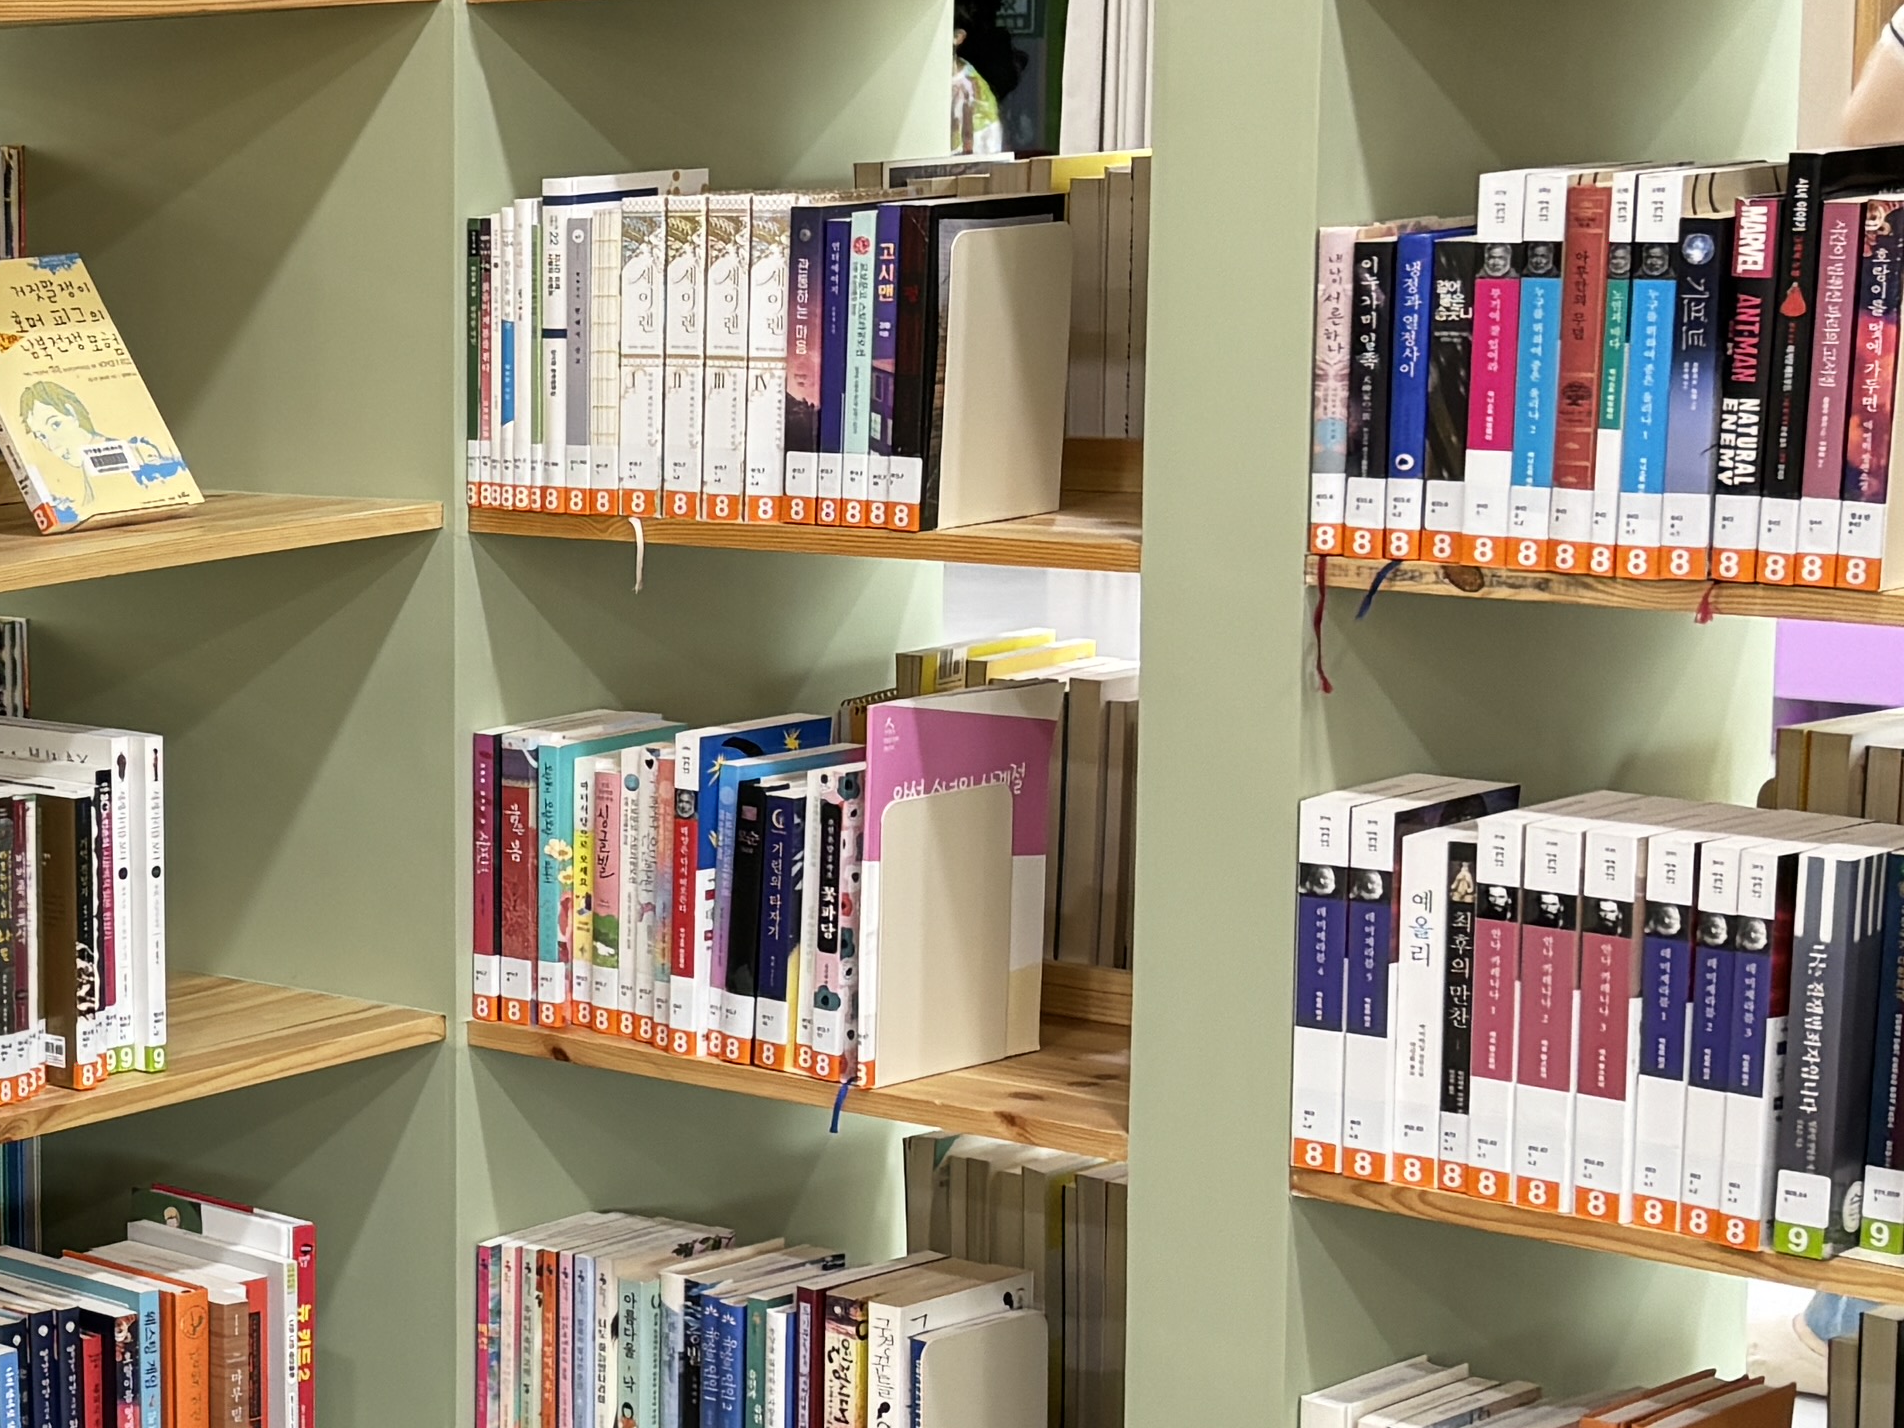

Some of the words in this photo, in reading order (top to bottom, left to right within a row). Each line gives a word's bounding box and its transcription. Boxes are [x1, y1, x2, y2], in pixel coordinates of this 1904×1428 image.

[1736, 205, 1768, 274] MARVEL
[10, 280, 91, 303] 거짓말쟁이
[877, 242, 896, 303] 고시맨
[1360, 255, 1380, 329] 이누가미
[1403, 261, 1422, 310] 냉정과
[49, 307, 106, 328] 피그의
[88, 332, 126, 357] 모험
[1717, 397, 1741, 487] ENEMY
[1732, 397, 1760, 486] NATURAL
[819, 885, 838, 942] 꽃파당
[1450, 910, 1475, 980] 최후의
[1447, 984, 1471, 1030] 만찬
[1787, 1226, 1809, 1253] 9
[297, 1325, 311, 1366] 키드
